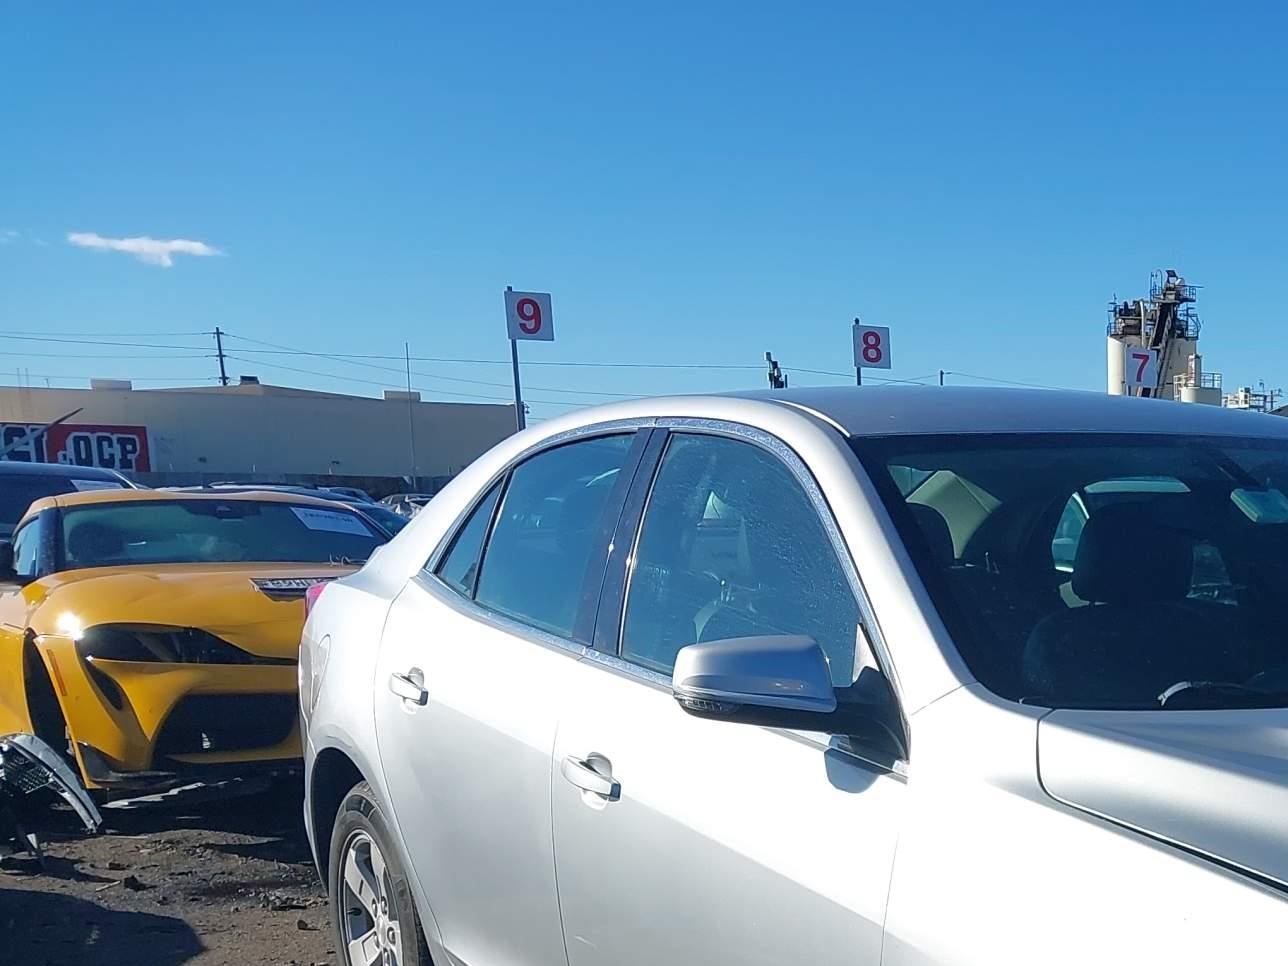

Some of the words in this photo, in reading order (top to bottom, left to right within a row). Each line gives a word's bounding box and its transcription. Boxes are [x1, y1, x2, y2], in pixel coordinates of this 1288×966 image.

[516, 298, 542, 335] 9
[862, 331, 882, 363] 8
[1131, 353, 1150, 382] 7
